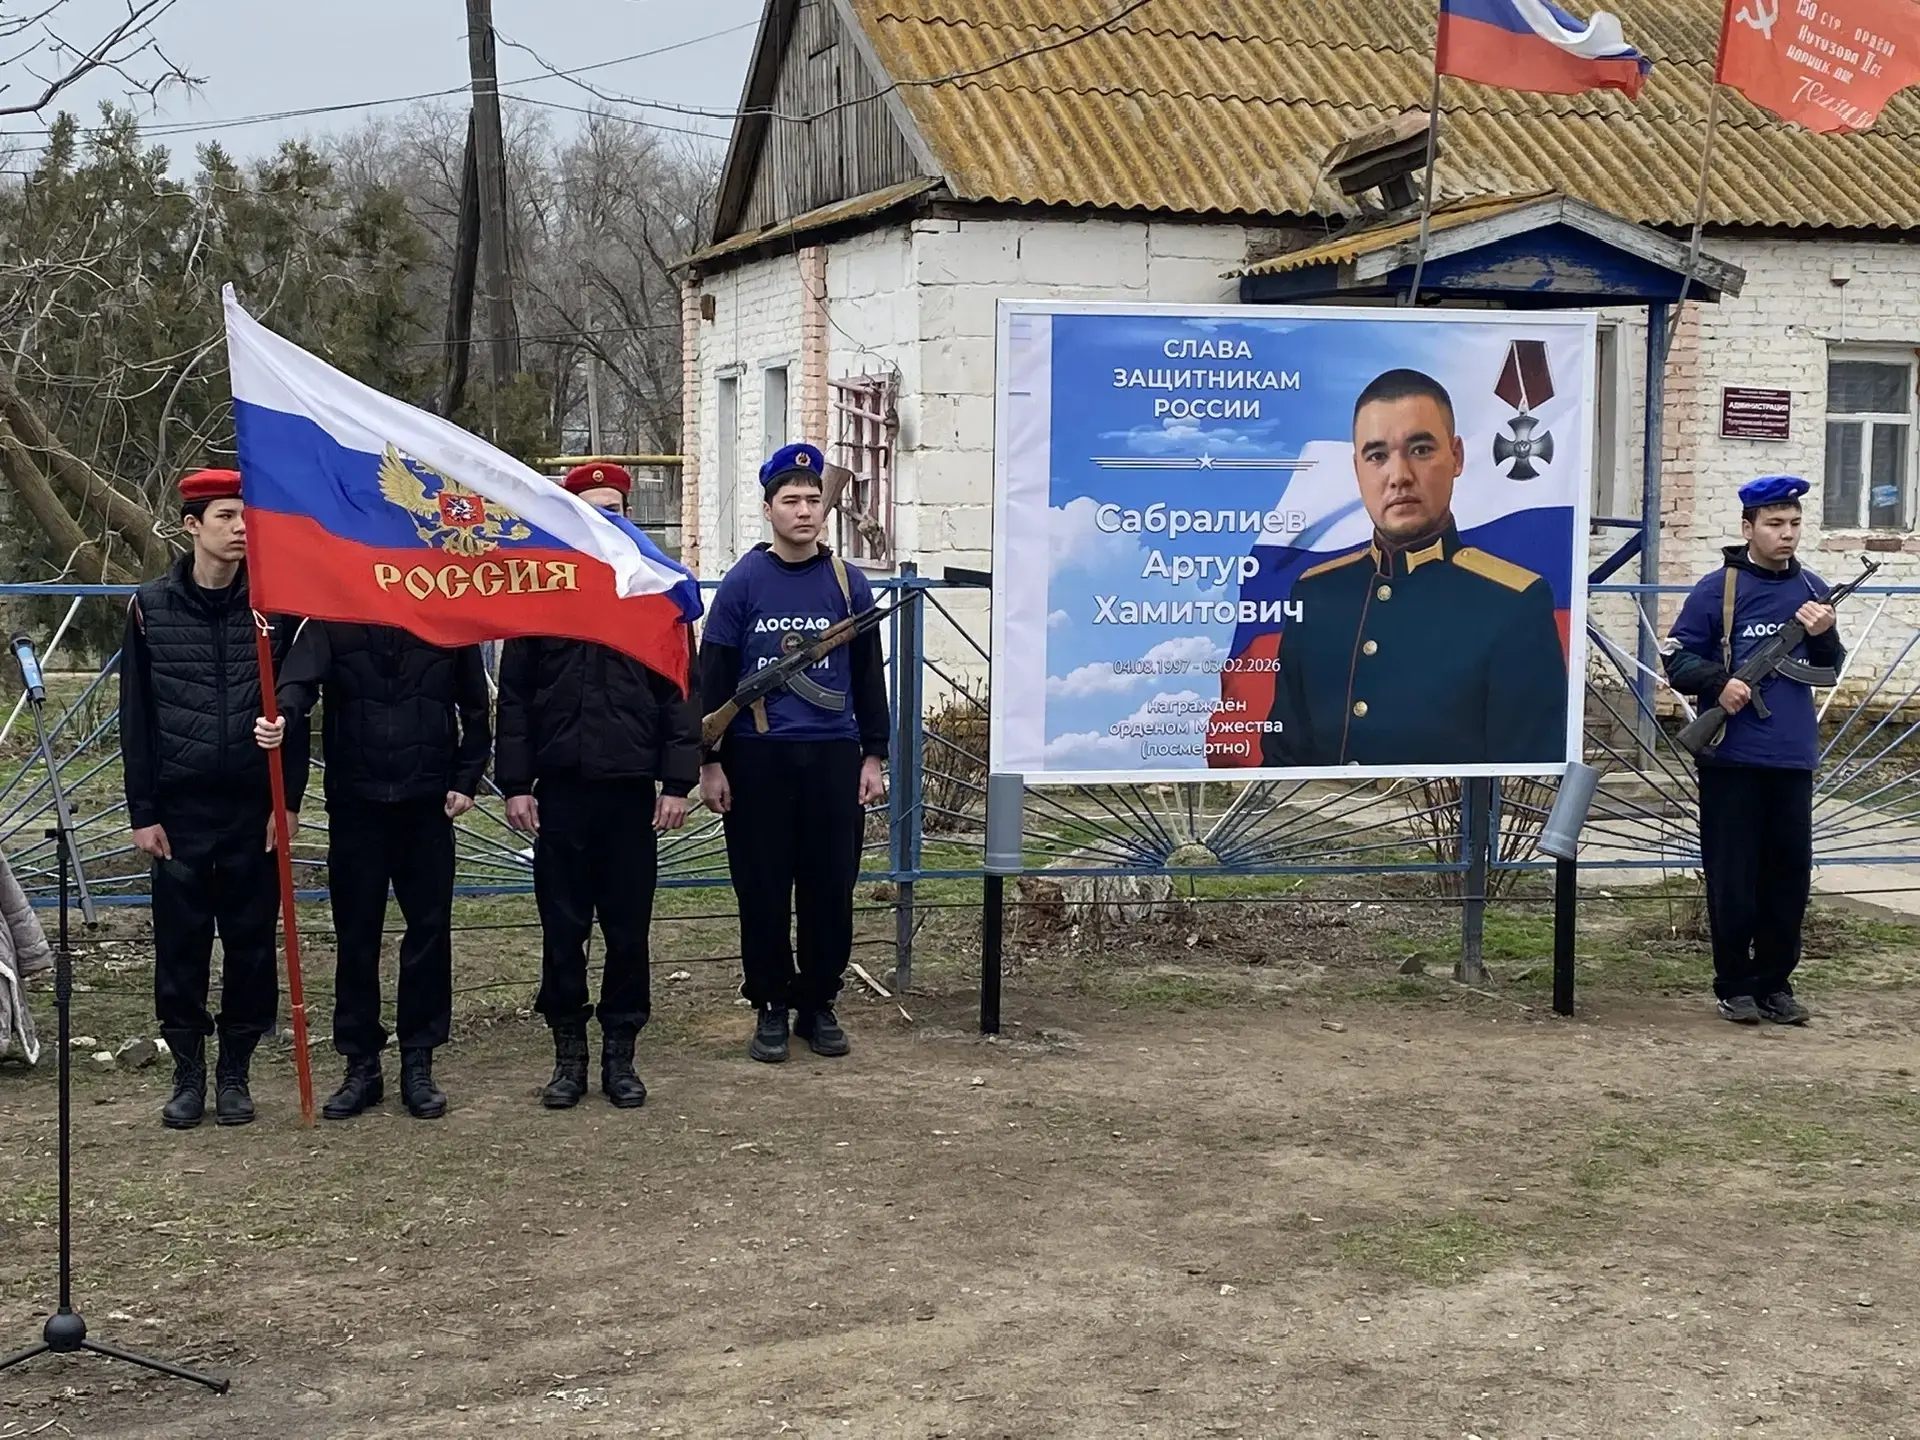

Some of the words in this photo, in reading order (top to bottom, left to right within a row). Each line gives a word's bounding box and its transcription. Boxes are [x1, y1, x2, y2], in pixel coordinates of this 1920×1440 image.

[1796, 0, 1818, 20] 150
[1163, 339, 1252, 359] СЛАВА
[1113, 368, 1300, 391] ЗАЩИТНИКАМ
[1154, 398, 1260, 419] РОССИИ
[1095, 502, 1307, 540] Сабралиев
[1141, 549, 1260, 586] Артур
[373, 559, 580, 601] РОССИЯ
[1092, 594, 1304, 624] Хамитович
[754, 617, 831, 633] ДОССАФ
[1113, 659, 1191, 675] 04.08.1997
[1147, 698, 1247, 714] награждён
[1109, 722, 1189, 738] орденом
[1195, 720, 1283, 737] Мужества
[1141, 740, 1250, 759] (посмертно)
